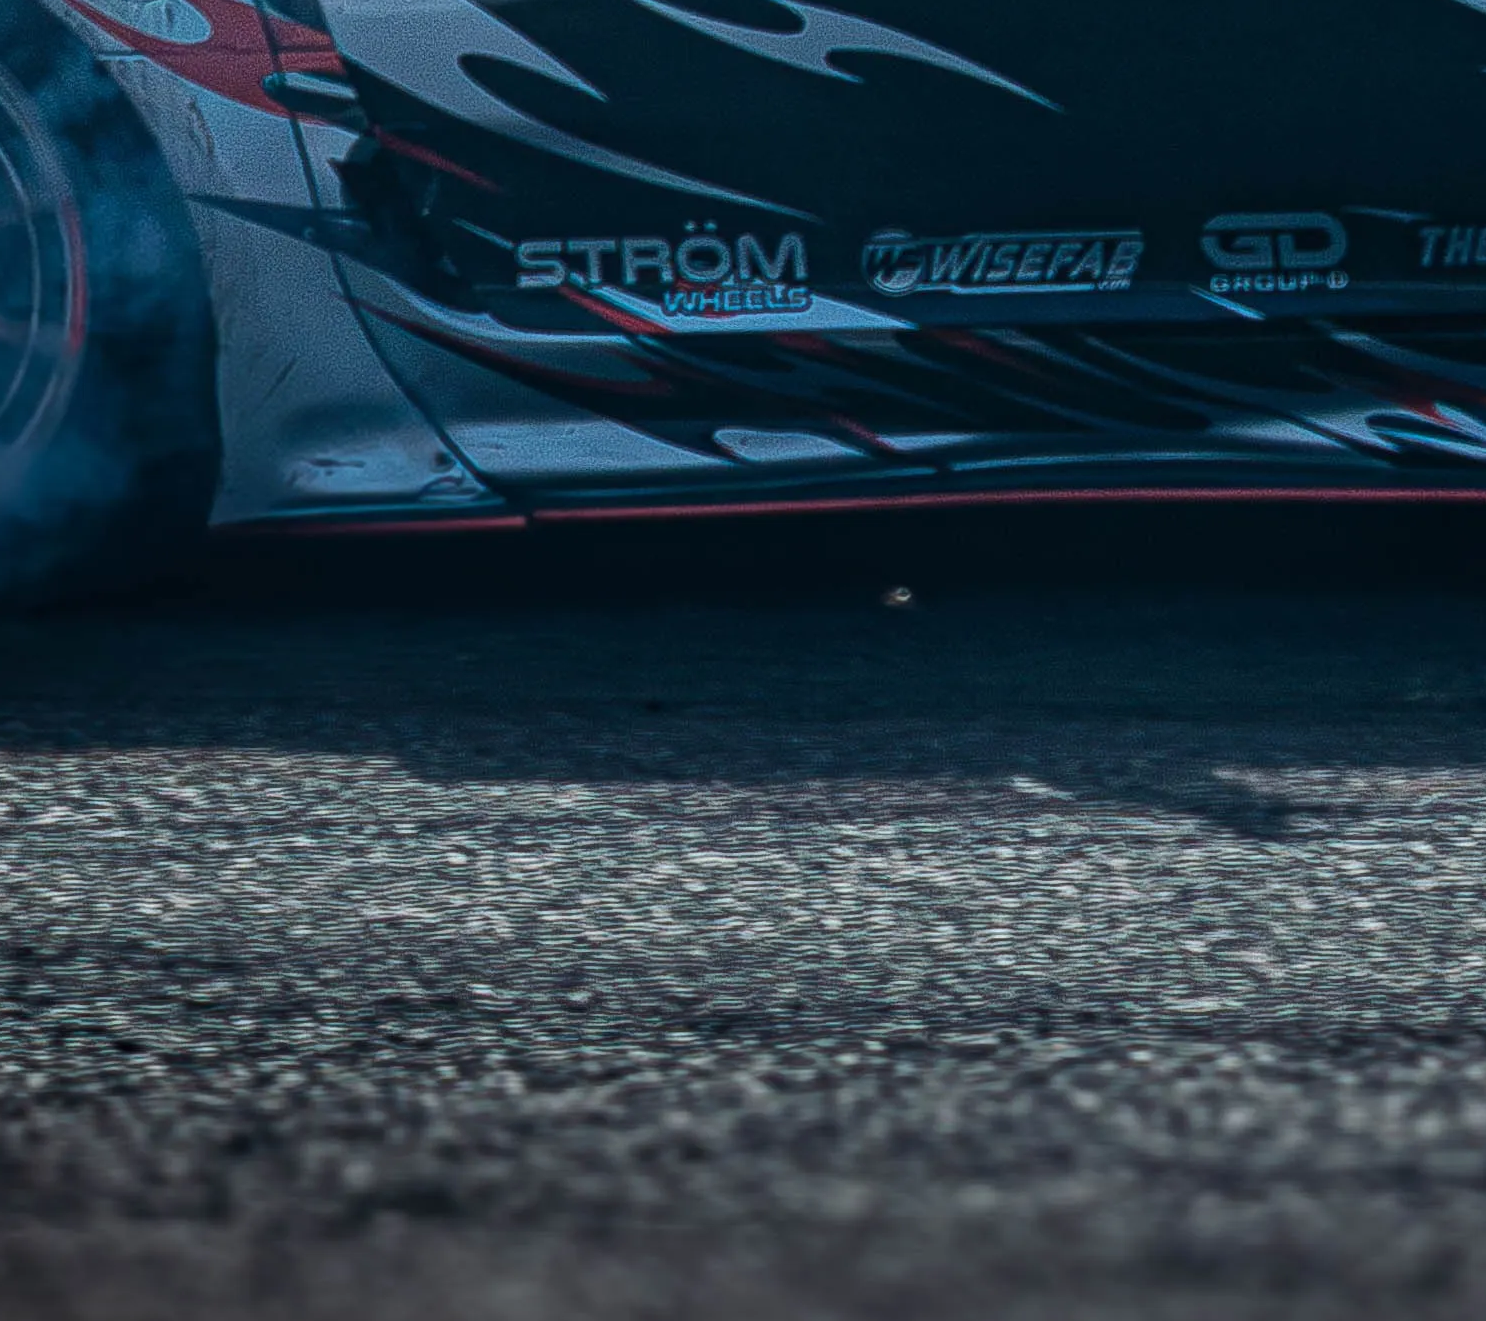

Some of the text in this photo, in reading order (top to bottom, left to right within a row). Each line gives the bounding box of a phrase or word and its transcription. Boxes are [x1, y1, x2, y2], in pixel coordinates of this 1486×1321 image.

[516, 220, 809, 288] STRÖM
[928, 239, 1144, 282] WISEFAB
[663, 286, 808, 312] WHEELS
